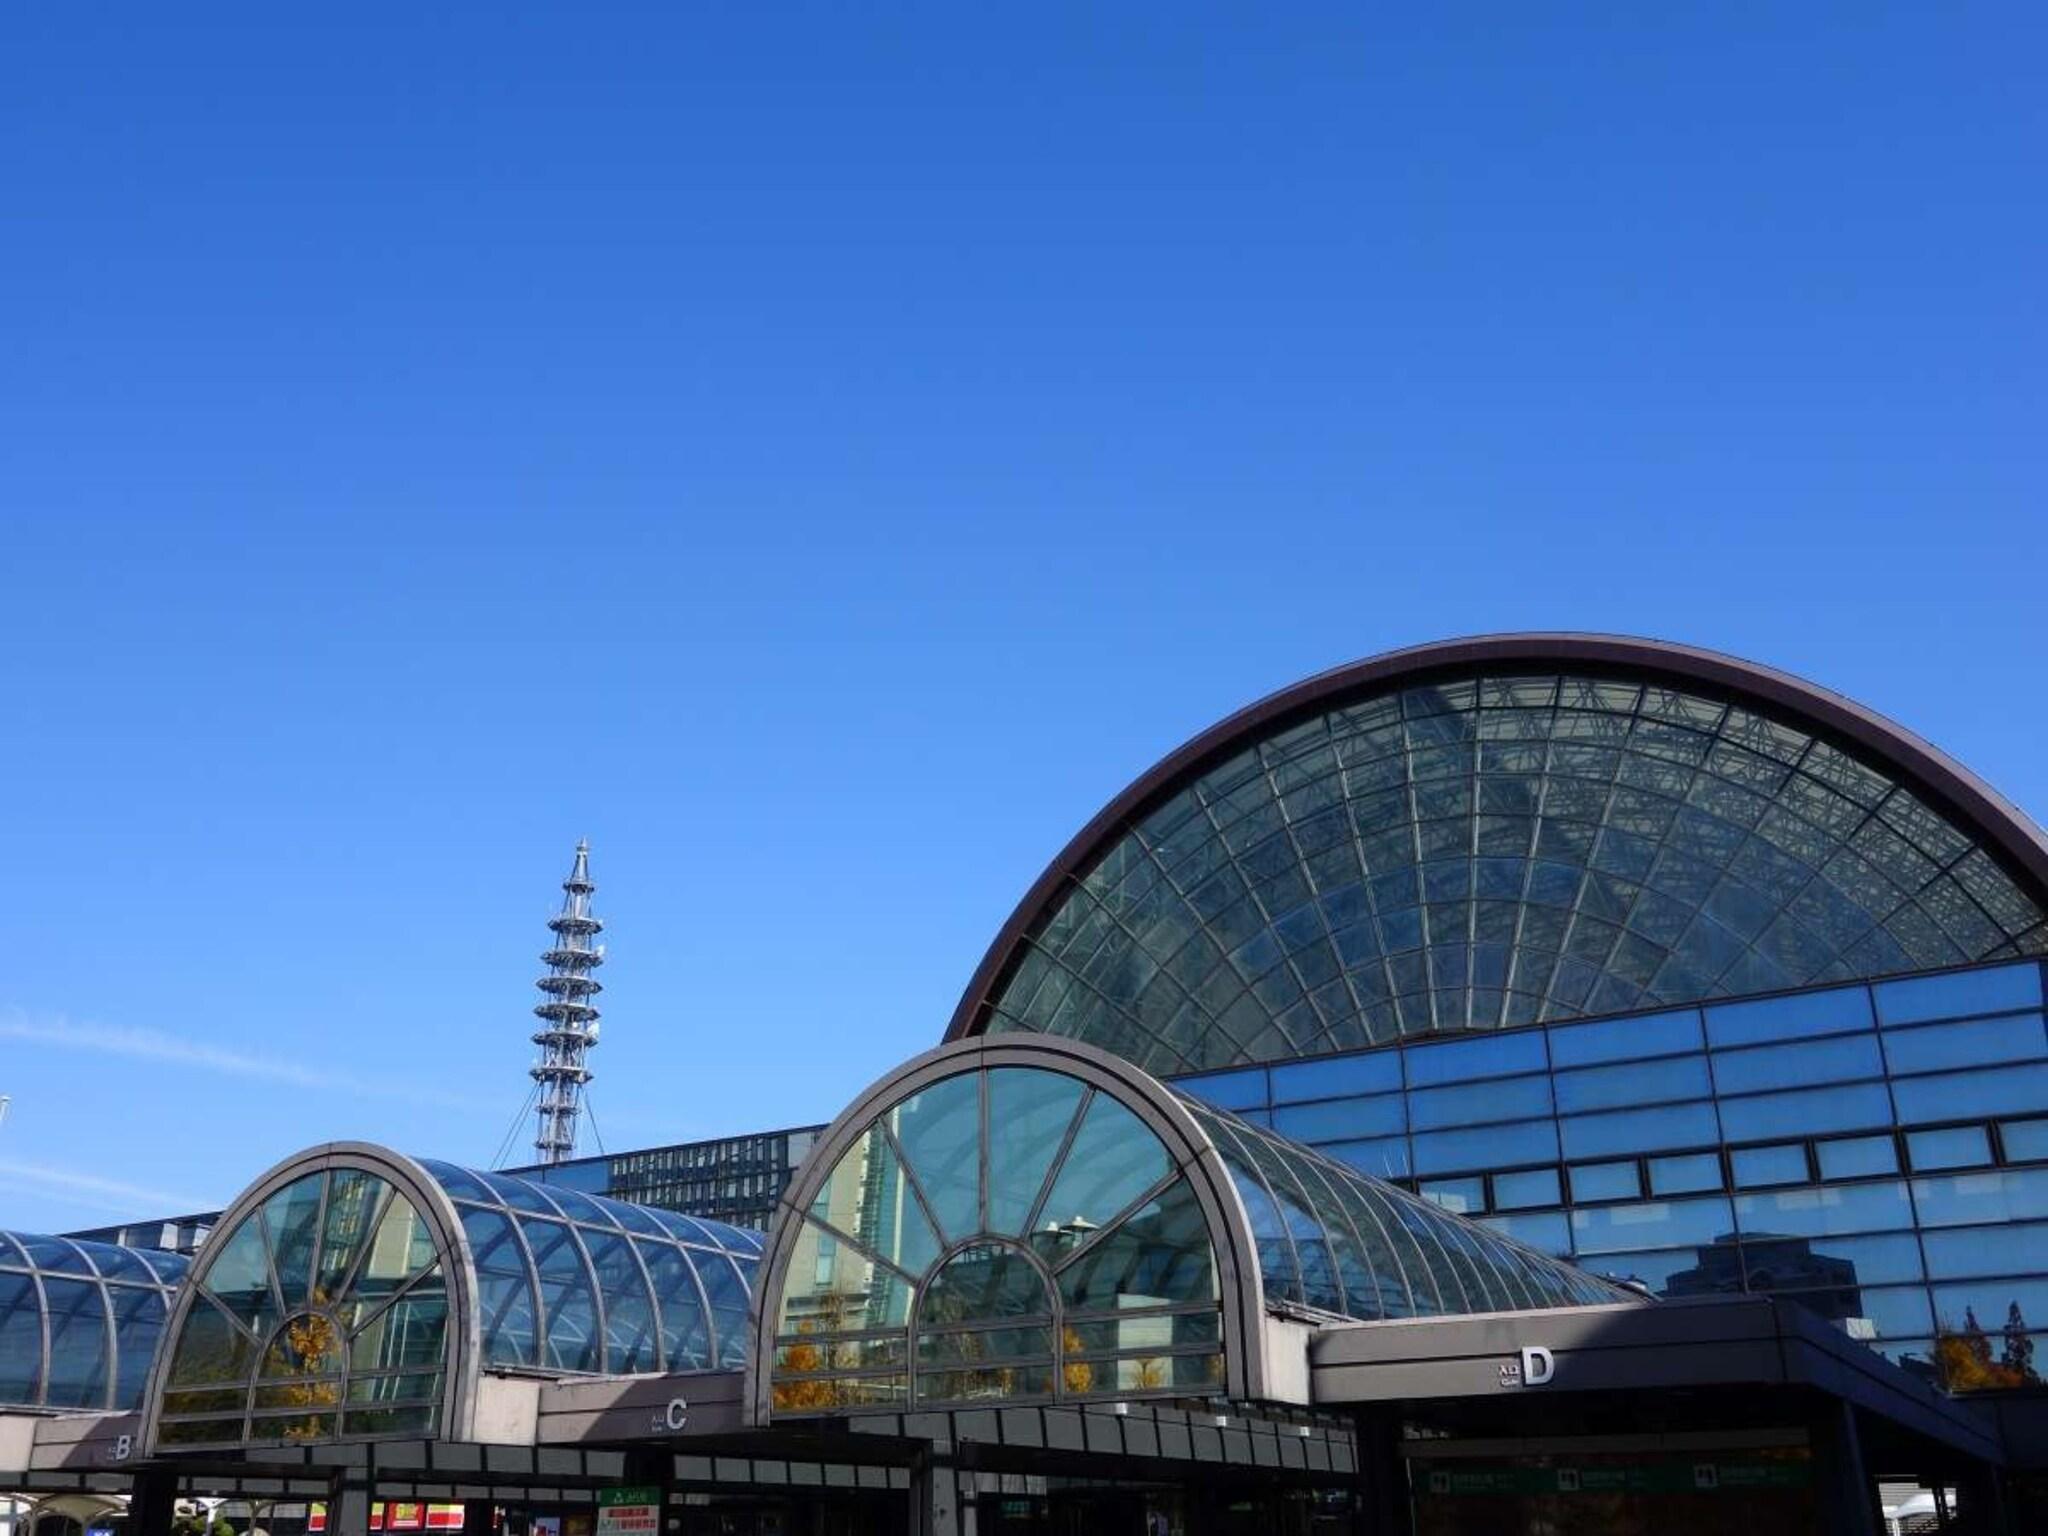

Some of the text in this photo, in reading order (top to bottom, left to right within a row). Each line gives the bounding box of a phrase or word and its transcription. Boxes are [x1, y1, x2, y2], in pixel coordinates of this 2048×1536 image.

[1522, 1346, 1554, 1385] D
[667, 1398, 687, 1430] C
[116, 1434, 131, 1460] B
